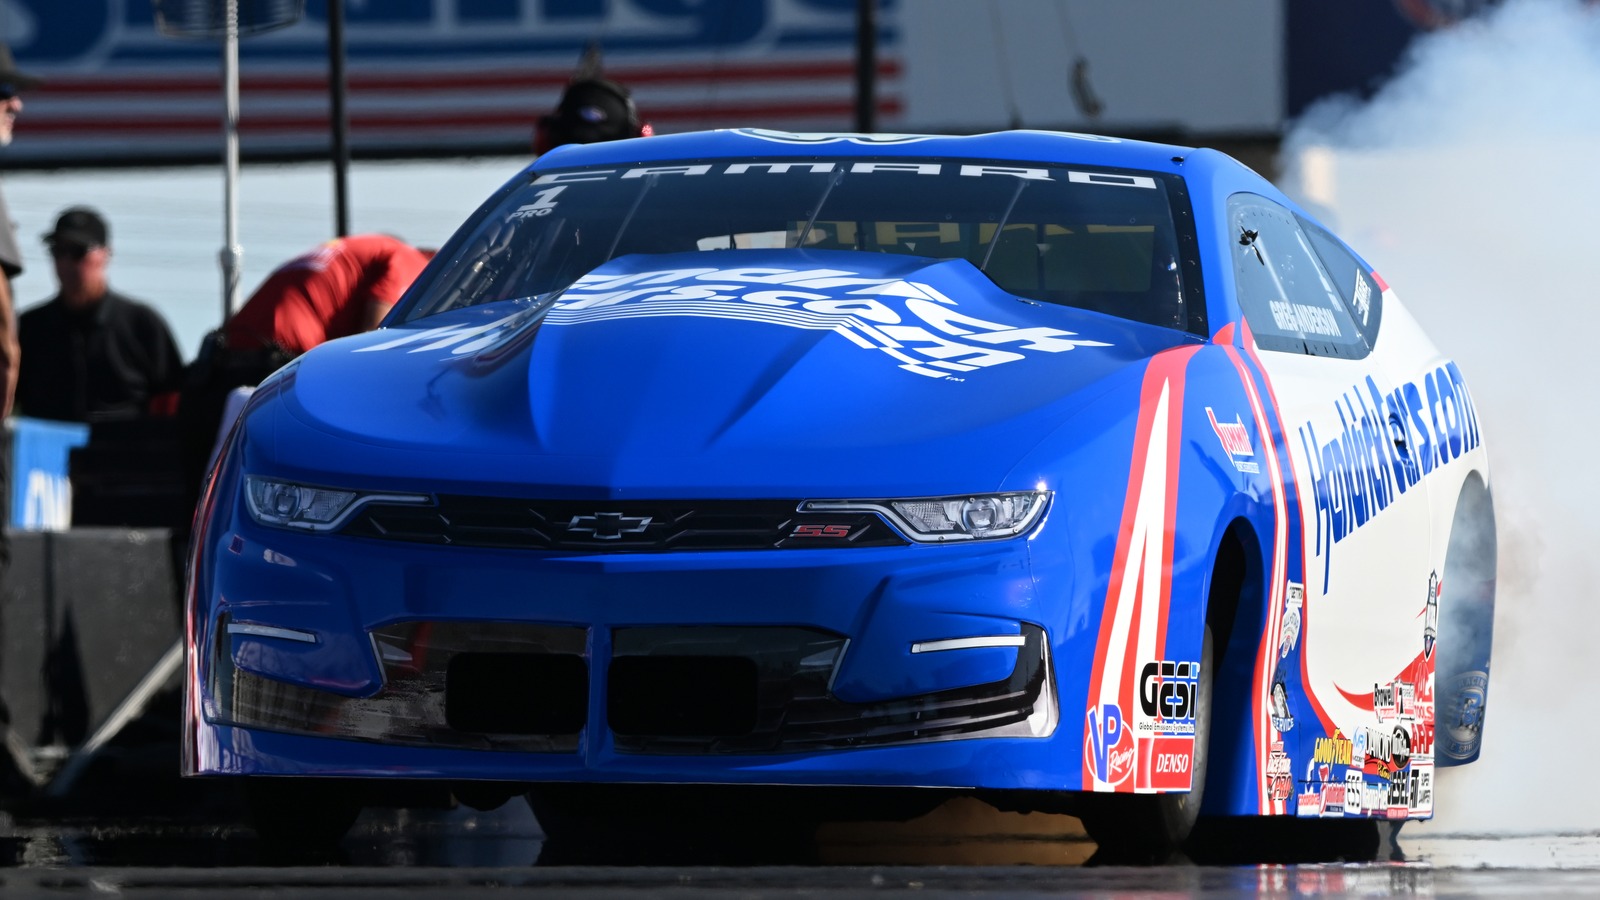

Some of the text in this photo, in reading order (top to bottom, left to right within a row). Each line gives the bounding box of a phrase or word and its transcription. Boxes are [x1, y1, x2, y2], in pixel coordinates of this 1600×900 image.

[529, 162, 1157, 190] CAMARO
[517, 185, 569, 211] 1
[505, 207, 553, 224] PRO
[1269, 300, 1299, 332] GREG
[1292, 303, 1342, 337] ANDERSON
[789, 525, 851, 538] SS
[1139, 721, 1153, 731] Global
[1410, 722, 1434, 754] ARP
[1088, 704, 1122, 784] VP
[1110, 745, 1135, 776] Racing
[1156, 753, 1189, 774] DENSO
